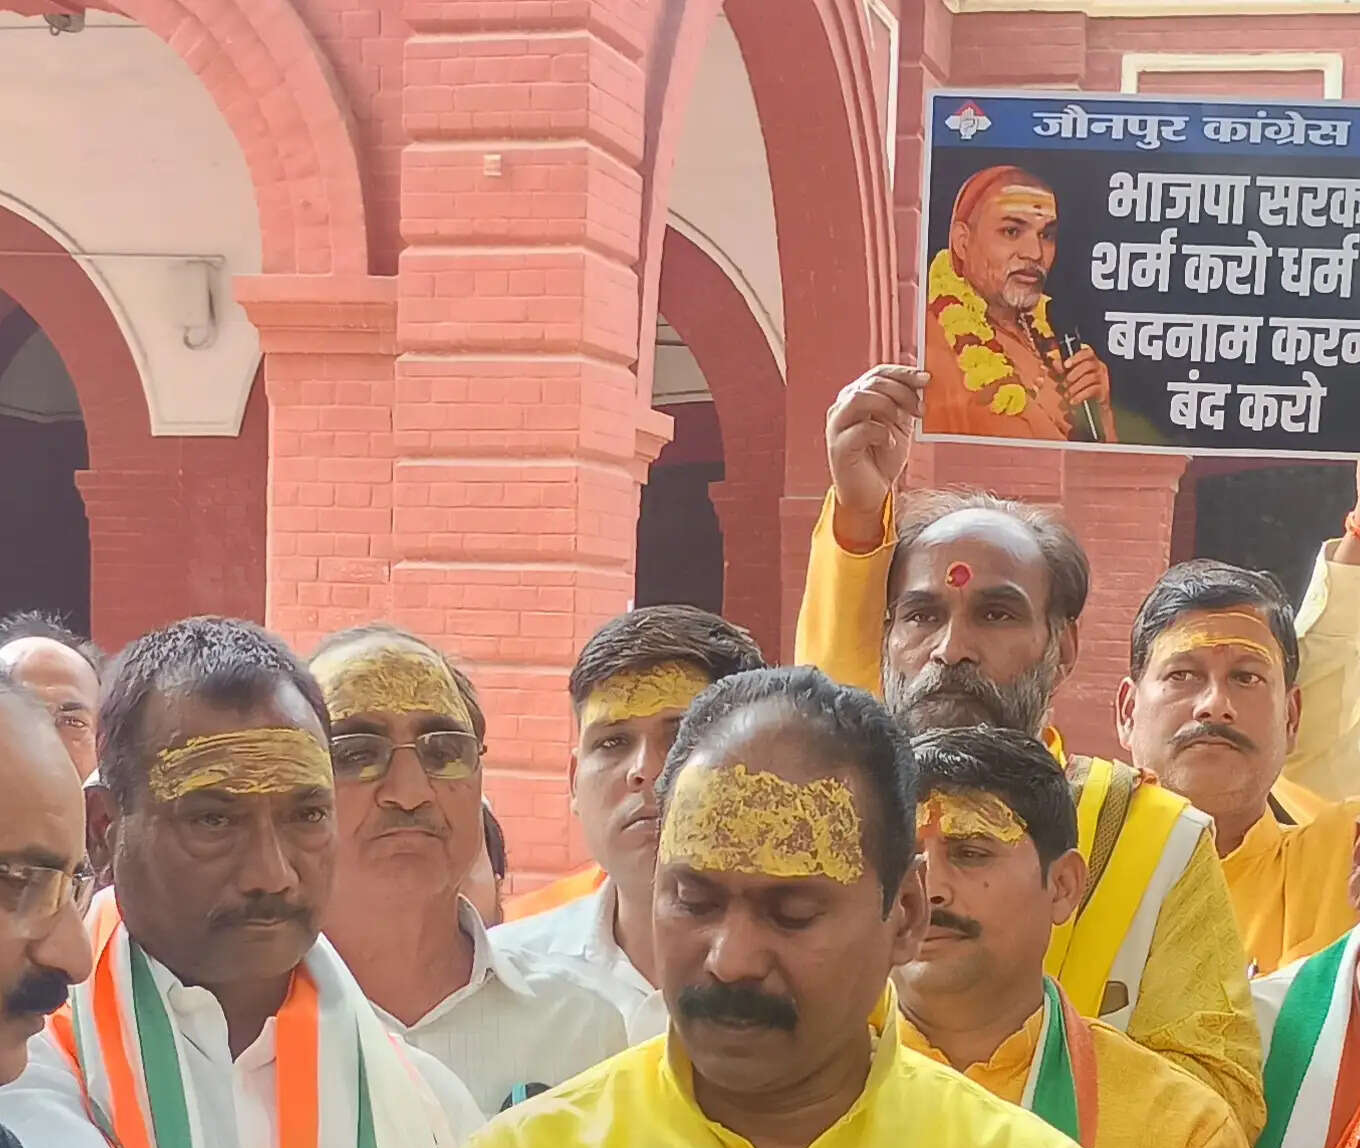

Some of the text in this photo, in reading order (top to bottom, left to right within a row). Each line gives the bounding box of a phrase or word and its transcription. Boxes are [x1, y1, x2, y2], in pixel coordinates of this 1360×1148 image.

[1032, 104, 1351, 148] जौनपुर कांग्रेस
[1108, 172, 1251, 225] भाजपा
[1090, 228, 1179, 294] शर्म
[1181, 230, 1274, 297] करो
[1104, 311, 1266, 364] बदनाम
[1166, 369, 1327, 434] बंद करो
